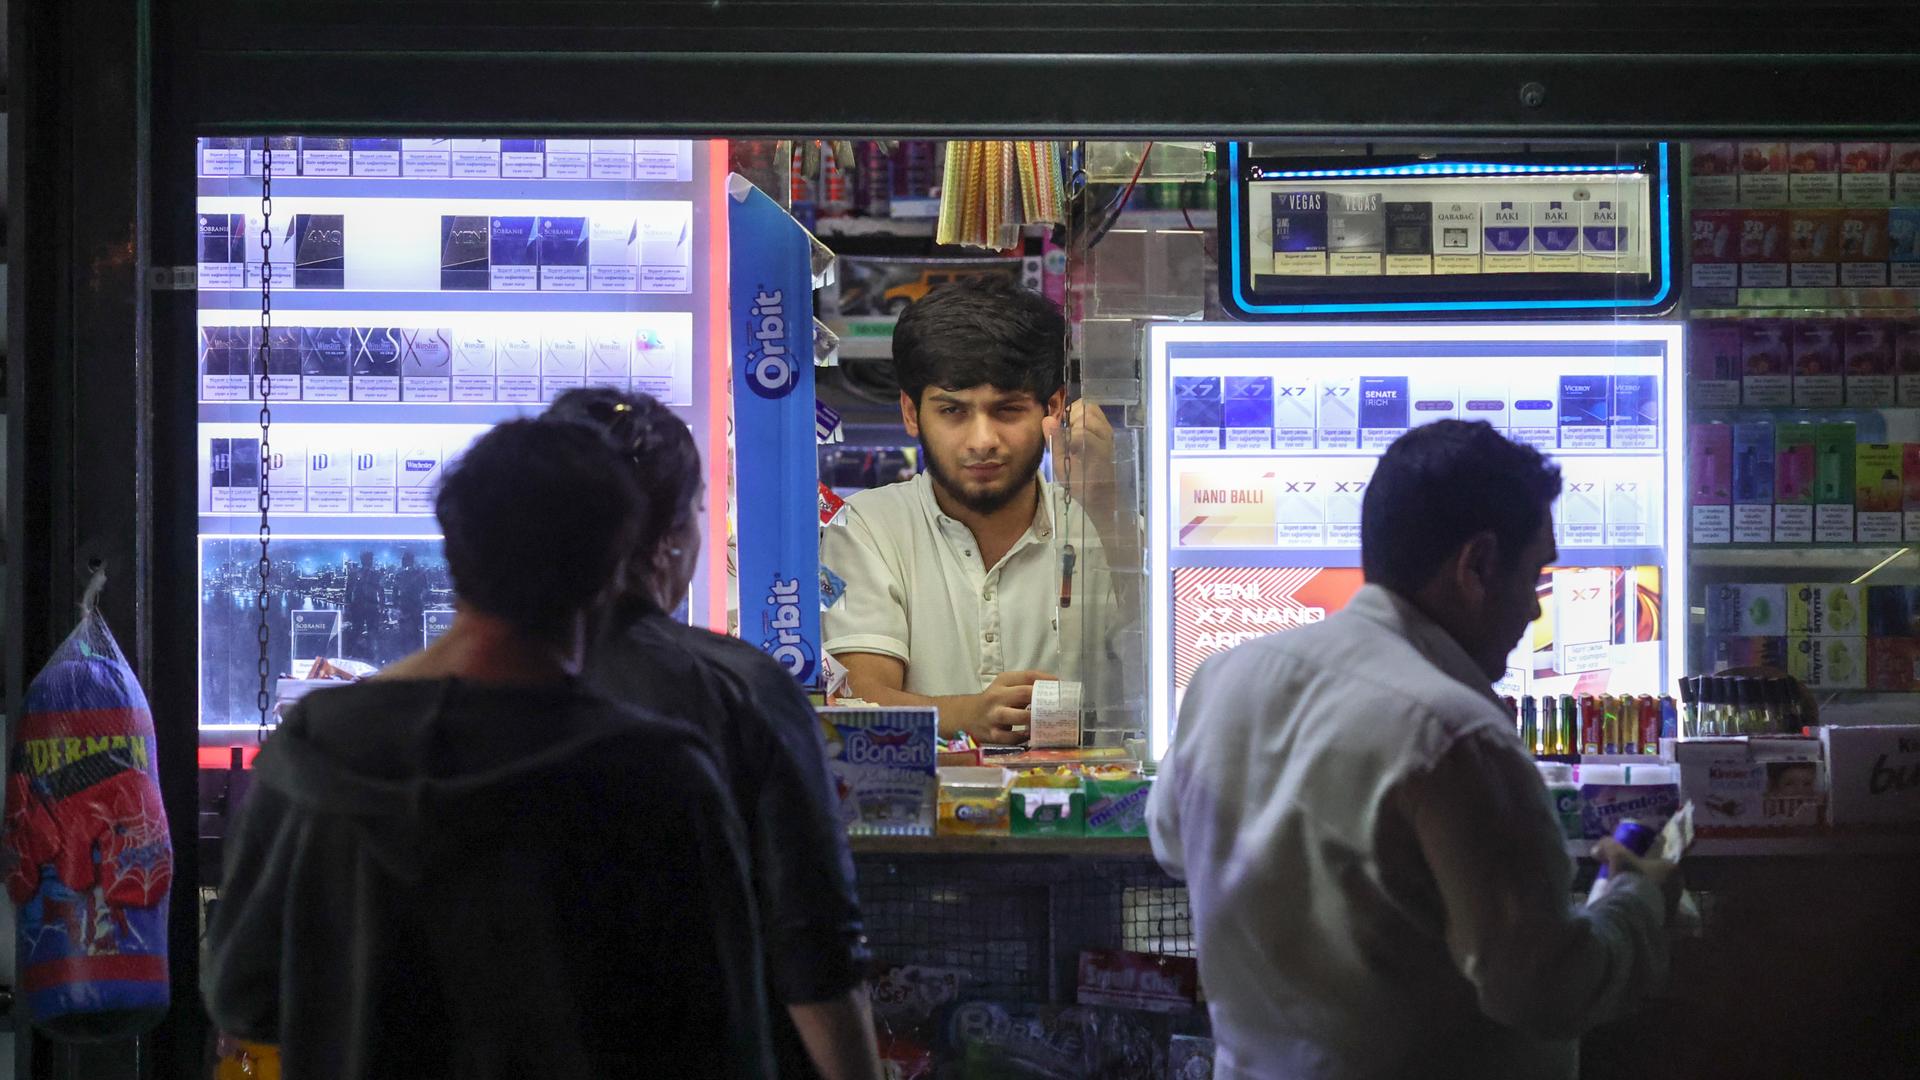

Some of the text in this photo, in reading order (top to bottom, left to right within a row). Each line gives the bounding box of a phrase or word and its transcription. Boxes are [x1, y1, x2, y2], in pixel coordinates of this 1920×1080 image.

[1289, 194, 1321, 210] VEGAS
[1345, 196, 1377, 211] VEGAS
[1495, 212, 1519, 221] BAKI
[1544, 212, 1568, 221] BAKI
[751, 288, 790, 390] Orbit
[1182, 384, 1213, 397] X7
[1233, 384, 1265, 397] X7
[1280, 387, 1306, 397] X7
[1325, 387, 1350, 397] X7
[1365, 390, 1398, 399] SENATE
[313, 453, 328, 471] LD
[358, 453, 373, 471] LD
[1285, 481, 1316, 493] X7
[1335, 481, 1366, 493] X7
[1569, 482, 1595, 493] X7
[1615, 482, 1638, 492] X7
[1193, 489, 1264, 504] NANO BALLI
[1571, 587, 1601, 602] X7
[1196, 606, 1326, 624] X7 NANO
[765, 578, 806, 677] Orbit
